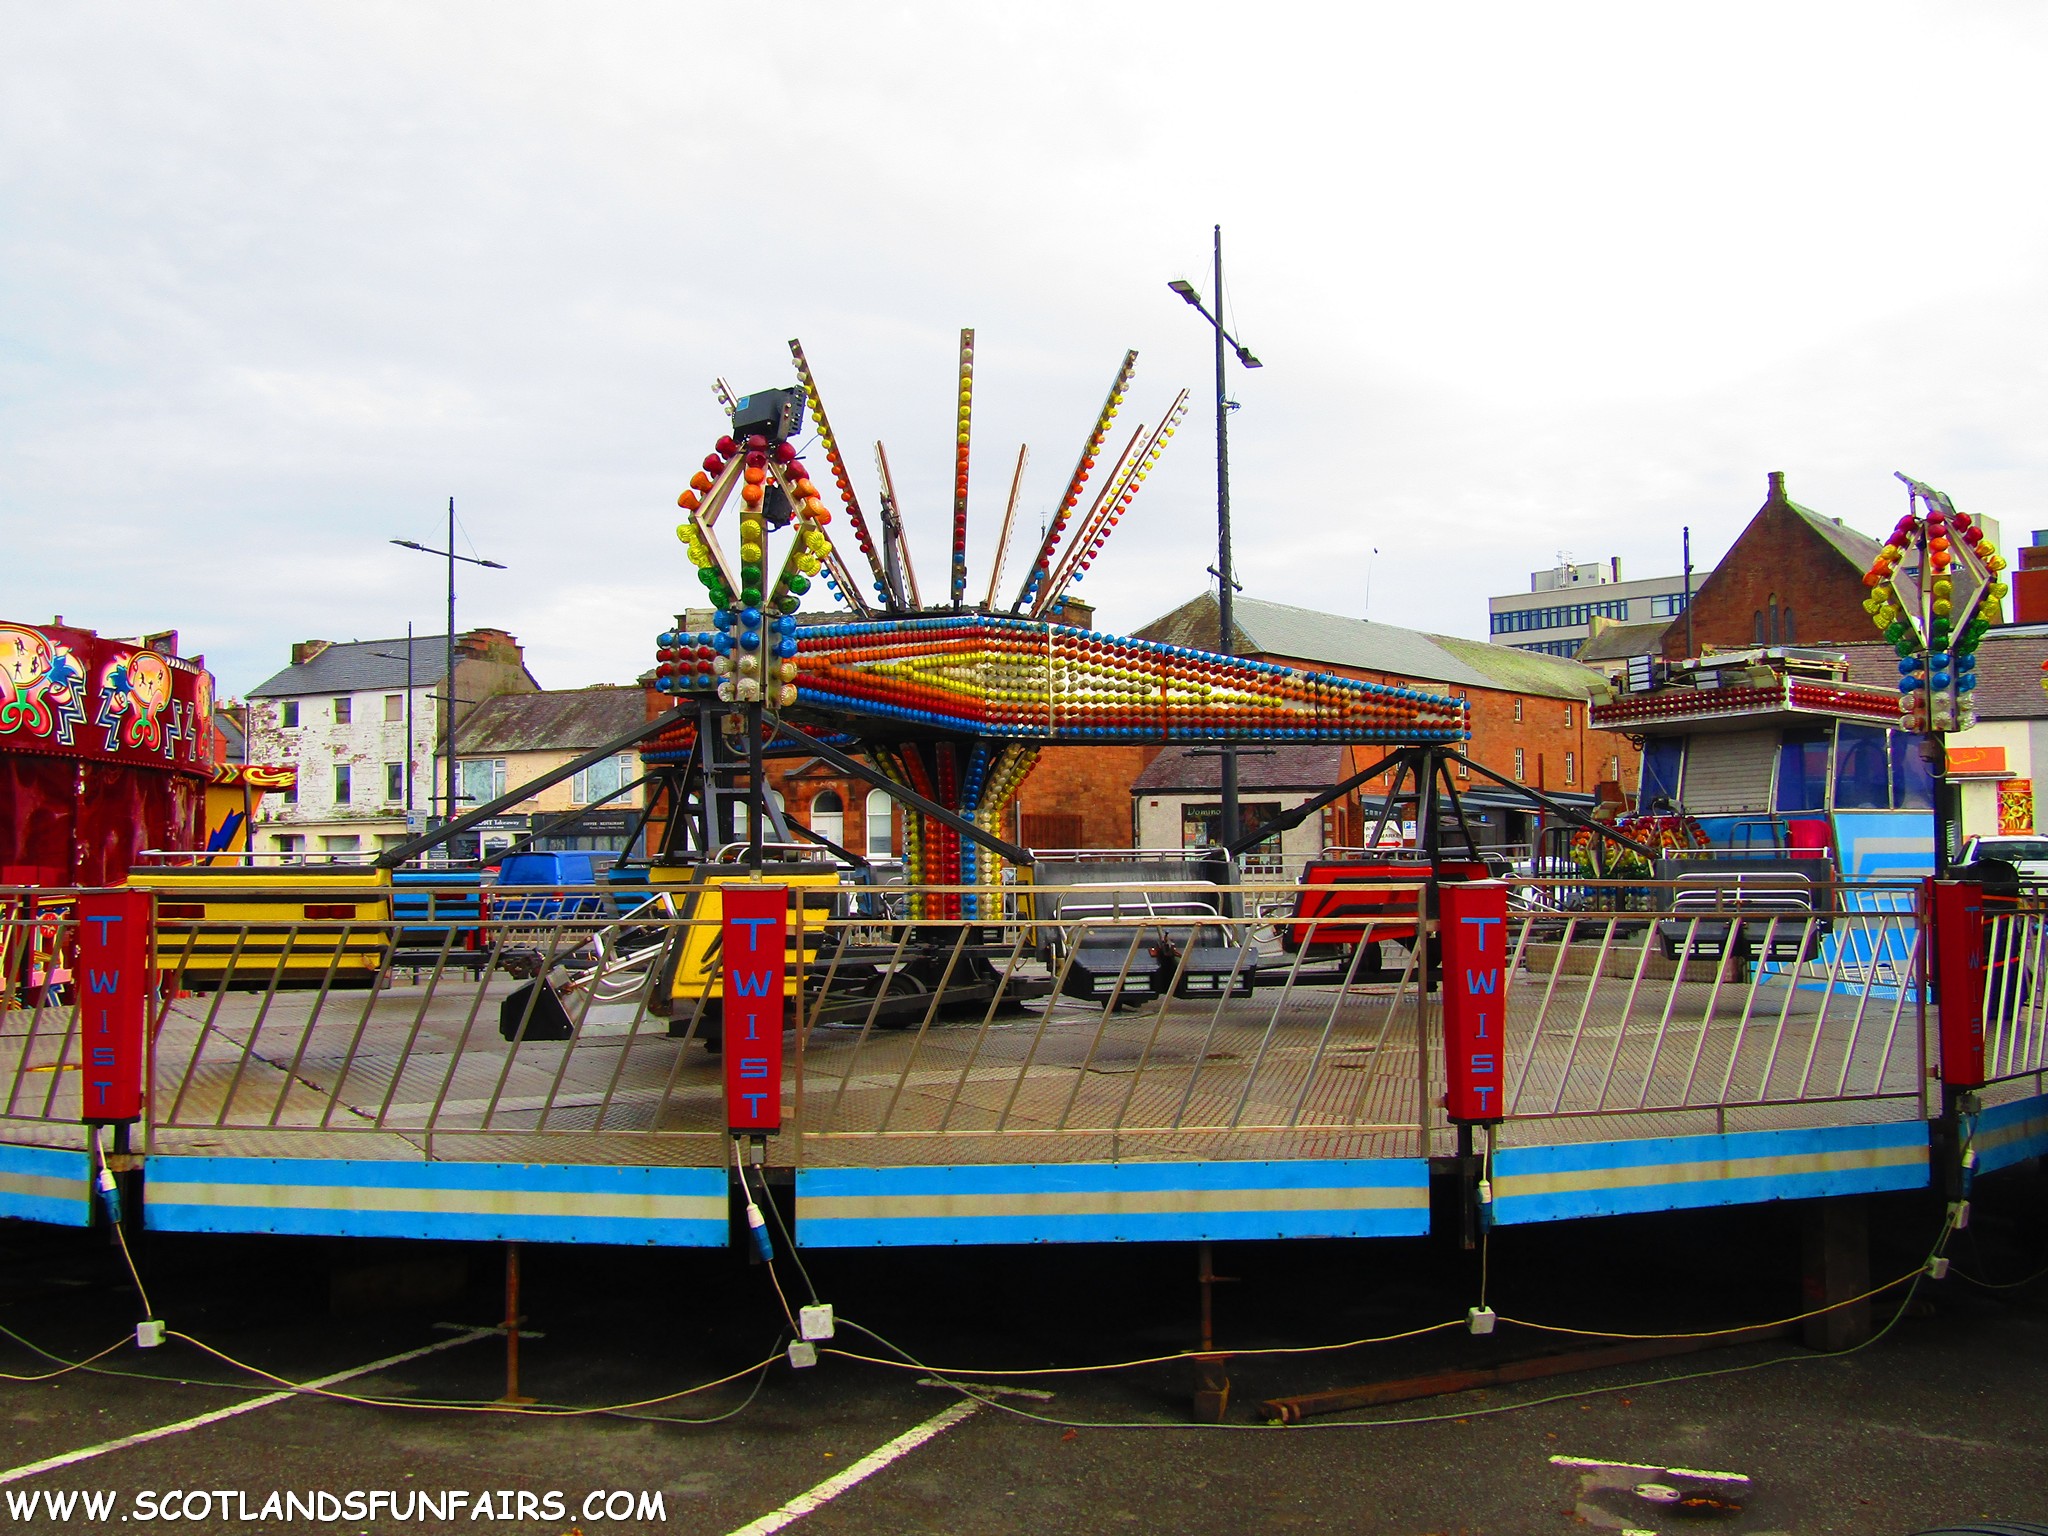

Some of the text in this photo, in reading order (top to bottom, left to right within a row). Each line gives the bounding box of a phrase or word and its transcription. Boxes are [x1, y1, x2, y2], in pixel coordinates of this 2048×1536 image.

[87, 915, 122, 1105] TWIST
[731, 917, 776, 1119] TWIST
[1461, 917, 1501, 1112] TWIST
